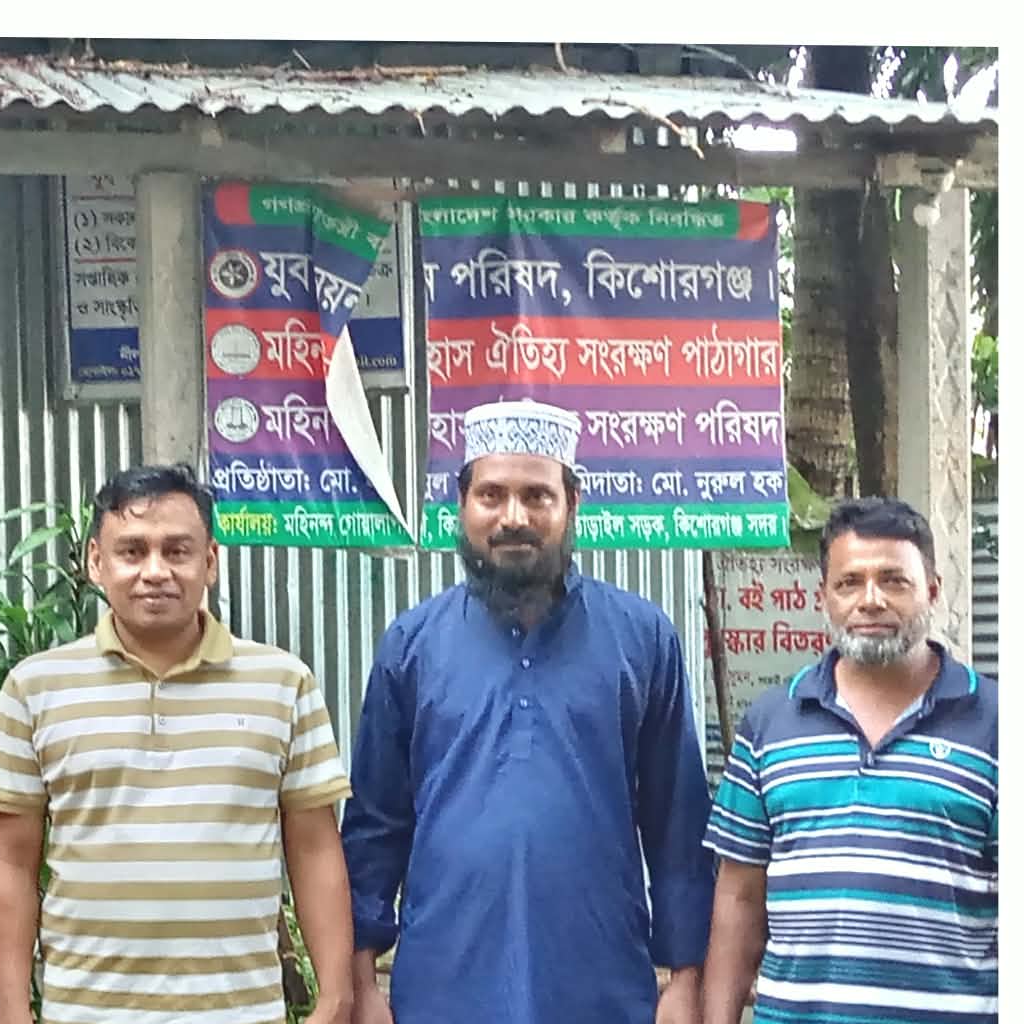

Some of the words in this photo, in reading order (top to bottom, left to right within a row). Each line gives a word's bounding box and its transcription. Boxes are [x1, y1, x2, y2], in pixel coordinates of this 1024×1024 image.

[450, 247, 573, 306] পরিষদ,
[485, 320, 570, 379] ঐতিহ্য
[576, 335, 673, 379] সংরক্ষণ
[681, 321, 778, 378] পাঠাগার
[585, 407, 686, 449] সংরক্ষণ
[750, 471, 784, 498] হক
[673, 507, 744, 537] কিশোরগঞ্জ
[738, 578, 764, 611] বই
[770, 580, 807, 611] পাঠ
